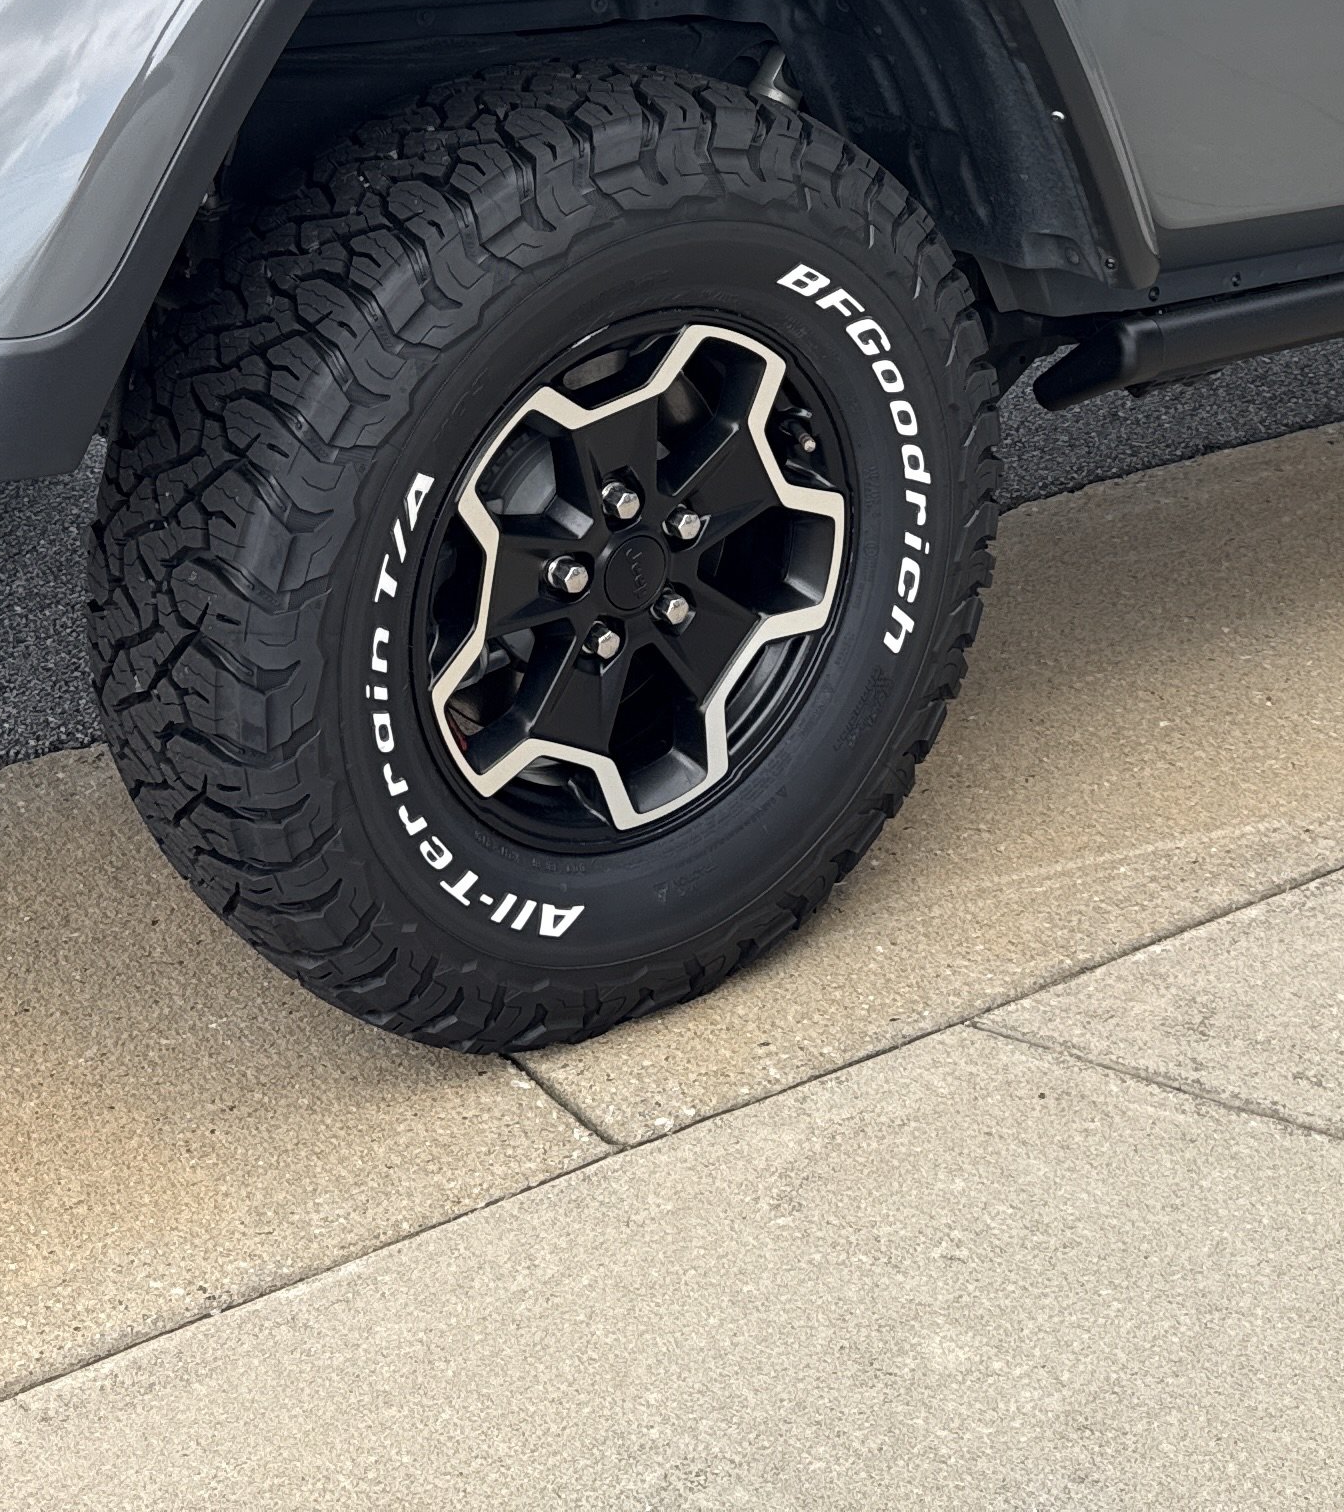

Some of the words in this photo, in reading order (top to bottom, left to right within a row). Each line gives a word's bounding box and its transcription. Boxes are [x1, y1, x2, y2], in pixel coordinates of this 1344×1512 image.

[374, 472, 436, 604] T/A
[776, 263, 933, 655] BFGoodrich
[364, 628, 586, 939] All-Terrain
